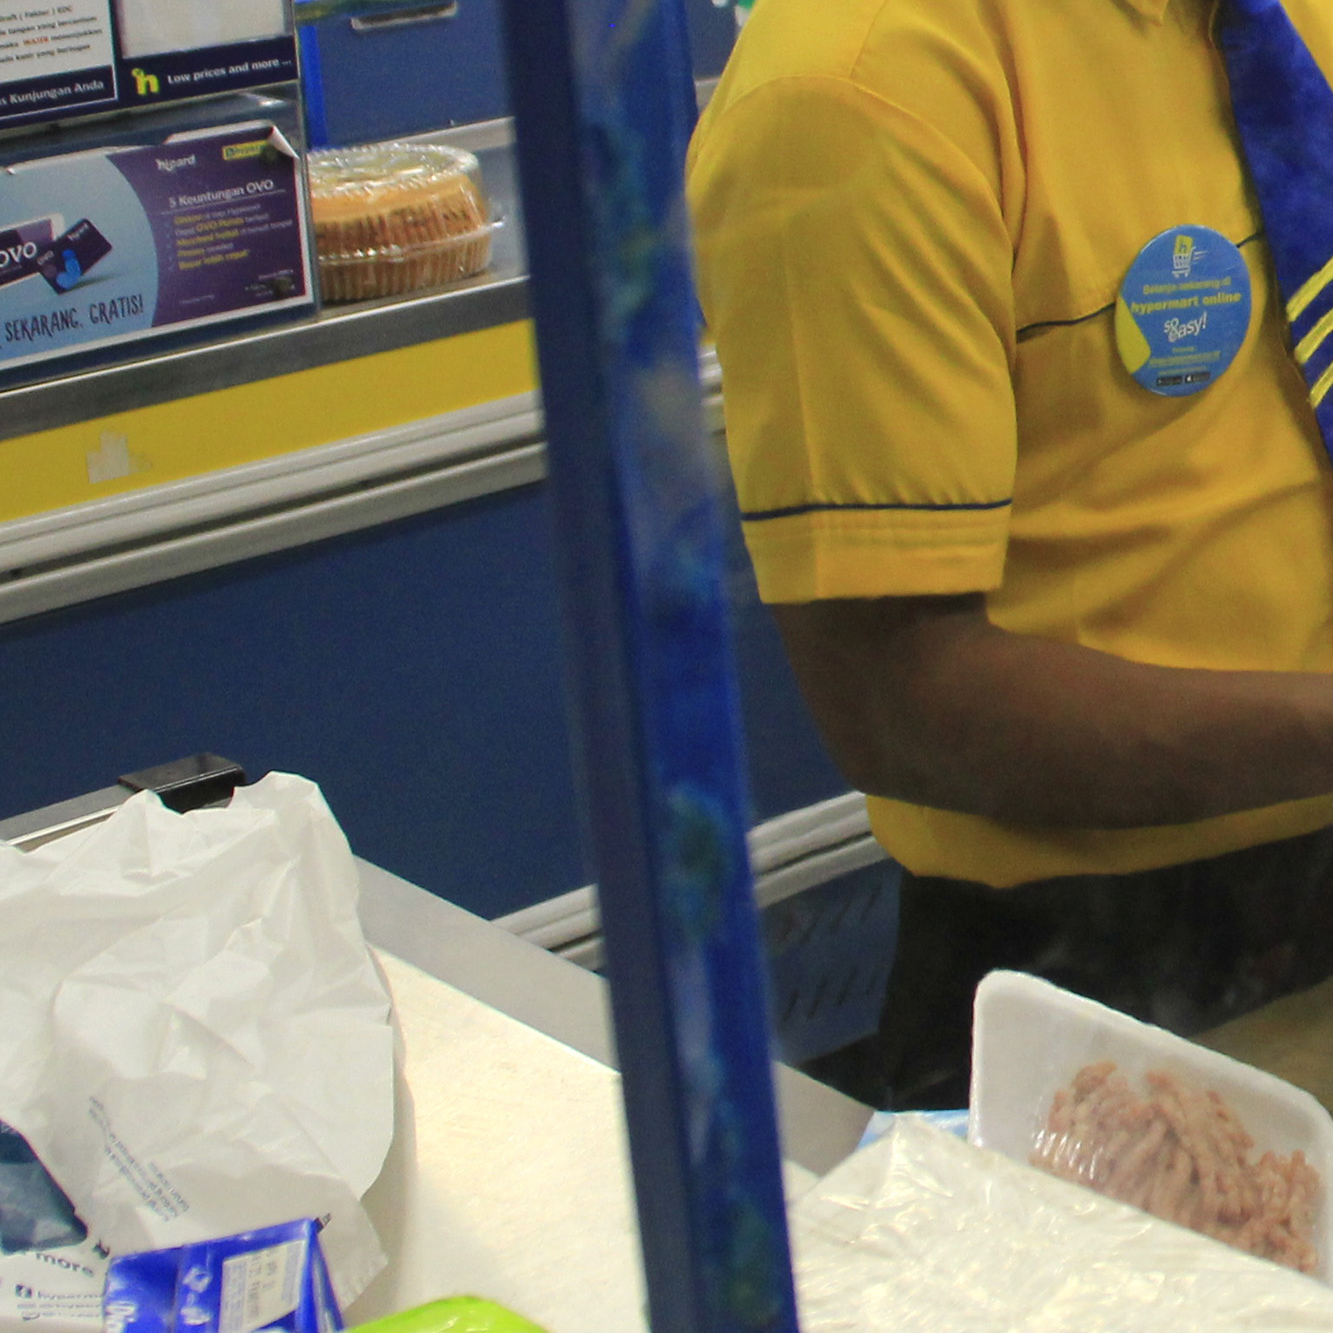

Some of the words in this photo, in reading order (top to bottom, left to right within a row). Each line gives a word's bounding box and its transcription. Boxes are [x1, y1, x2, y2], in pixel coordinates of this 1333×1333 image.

[167, 73, 191, 84] Low
[193, 68, 226, 83] prices
[229, 62, 249, 74] and
[251, 56, 280, 71] more
[9, 86, 72, 104] Kunjungan
[74, 80, 104, 93] Anda
[179, 185, 245, 209] Keuntungan
[246, 178, 274, 195] OVO
[89, 293, 144, 325] GRATIS!
[1131, 295, 1199, 315] hypermart
[1202, 291, 1241, 307] online
[36, 1252, 95, 1278] more
